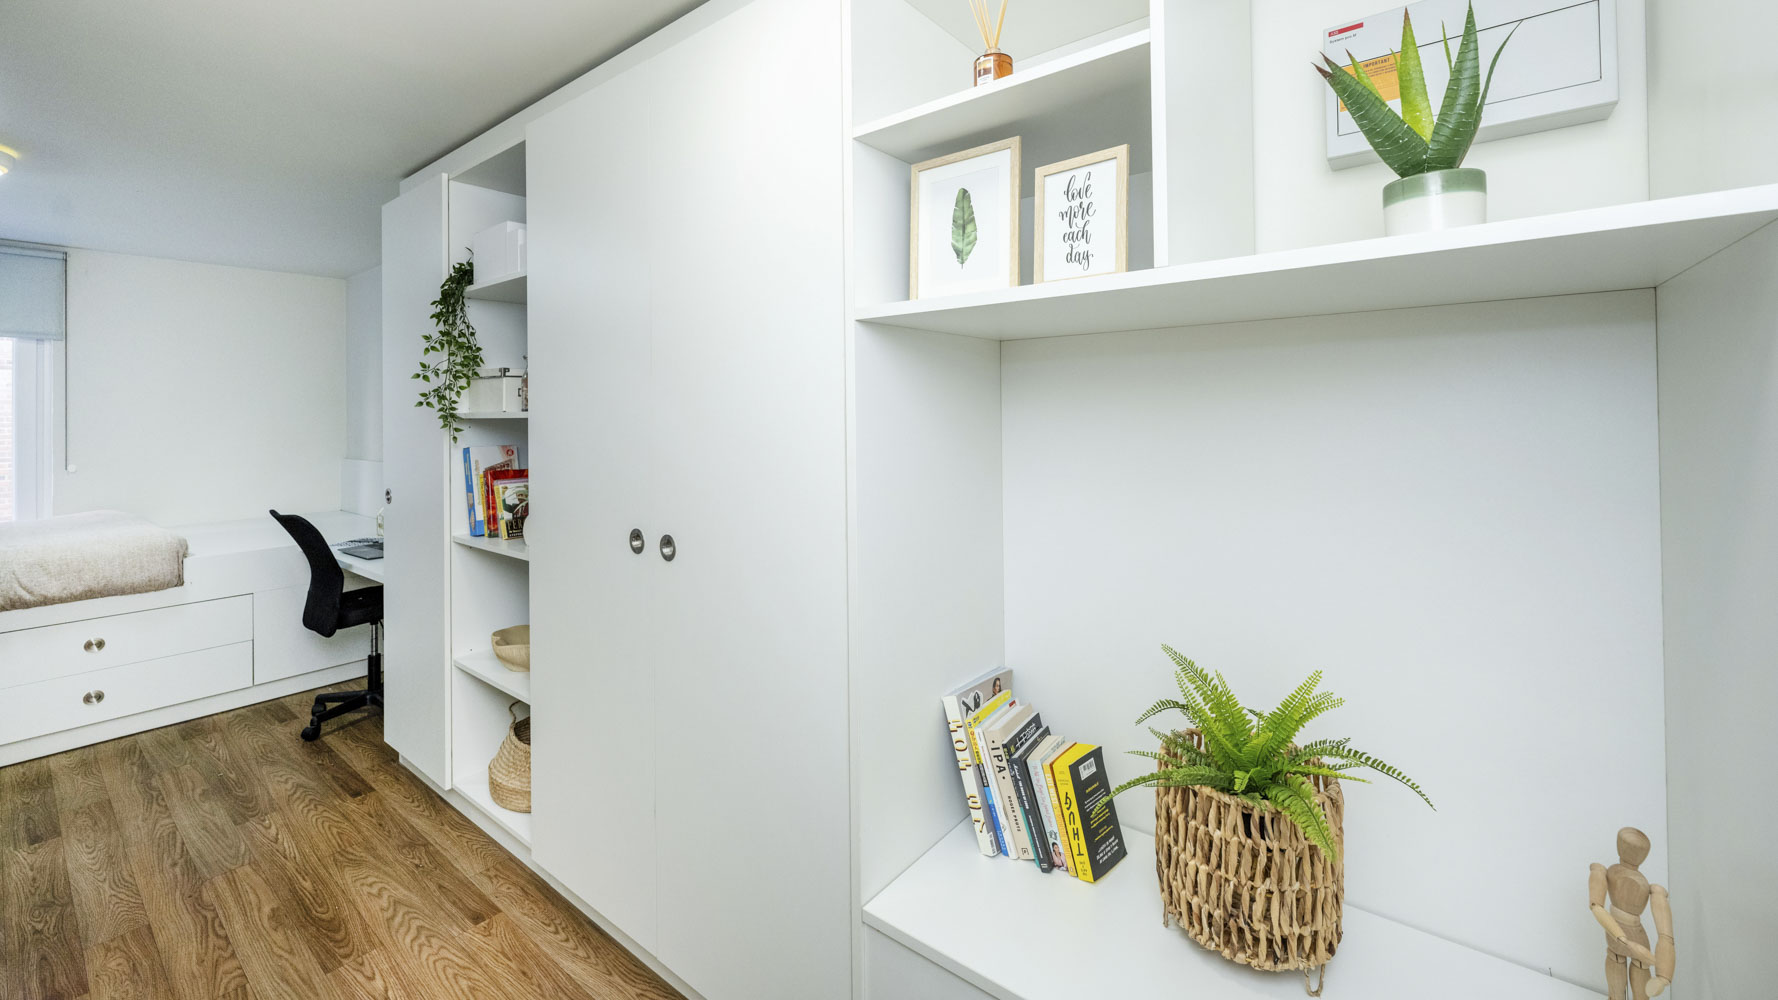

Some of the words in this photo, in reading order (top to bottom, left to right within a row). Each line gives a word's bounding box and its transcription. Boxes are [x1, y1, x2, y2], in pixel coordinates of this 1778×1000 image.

[1363, 58, 1390, 68] IMPORTANT
[1063, 171, 1093, 203] love
[1058, 201, 1097, 229] more
[1062, 219, 1092, 245] each
[1064, 792, 1084, 856] THUG
